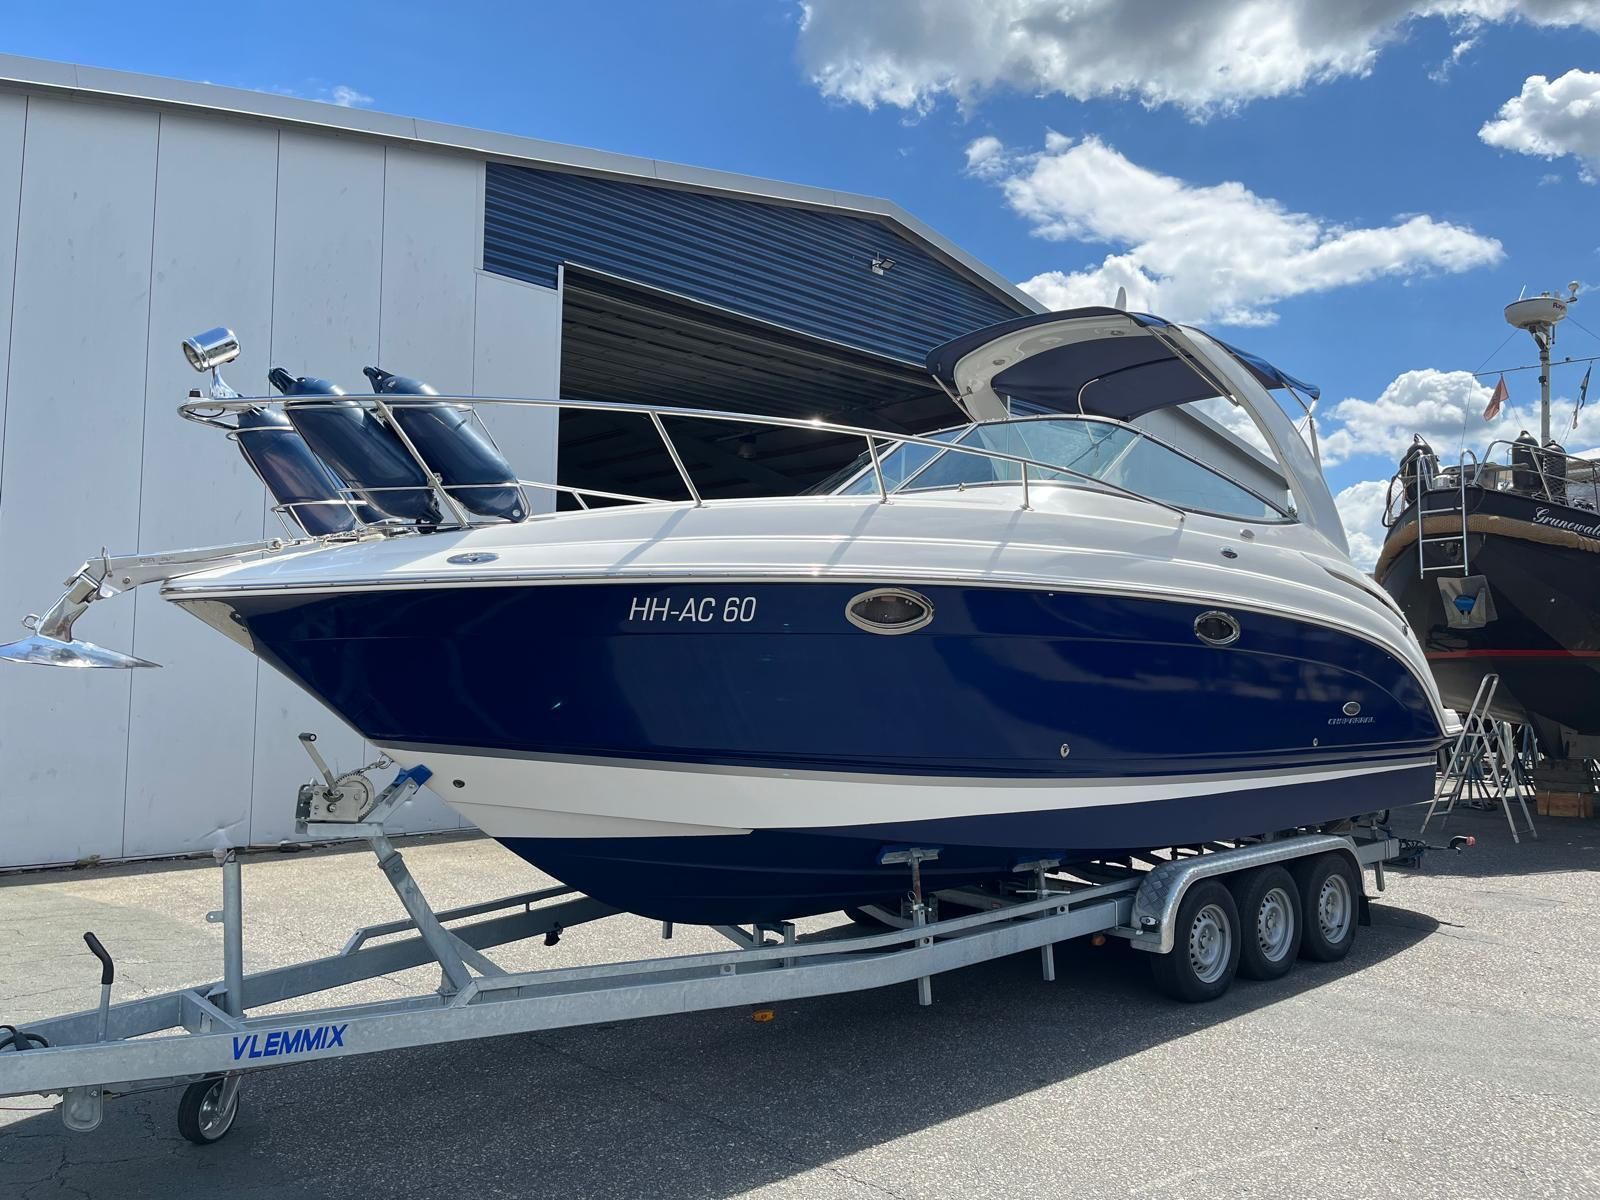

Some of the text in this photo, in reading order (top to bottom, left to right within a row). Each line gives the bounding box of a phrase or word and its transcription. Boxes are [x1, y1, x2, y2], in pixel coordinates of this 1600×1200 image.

[629, 596, 757, 622] HH-AC 60
[232, 1023, 349, 1061] VLEMMIX
